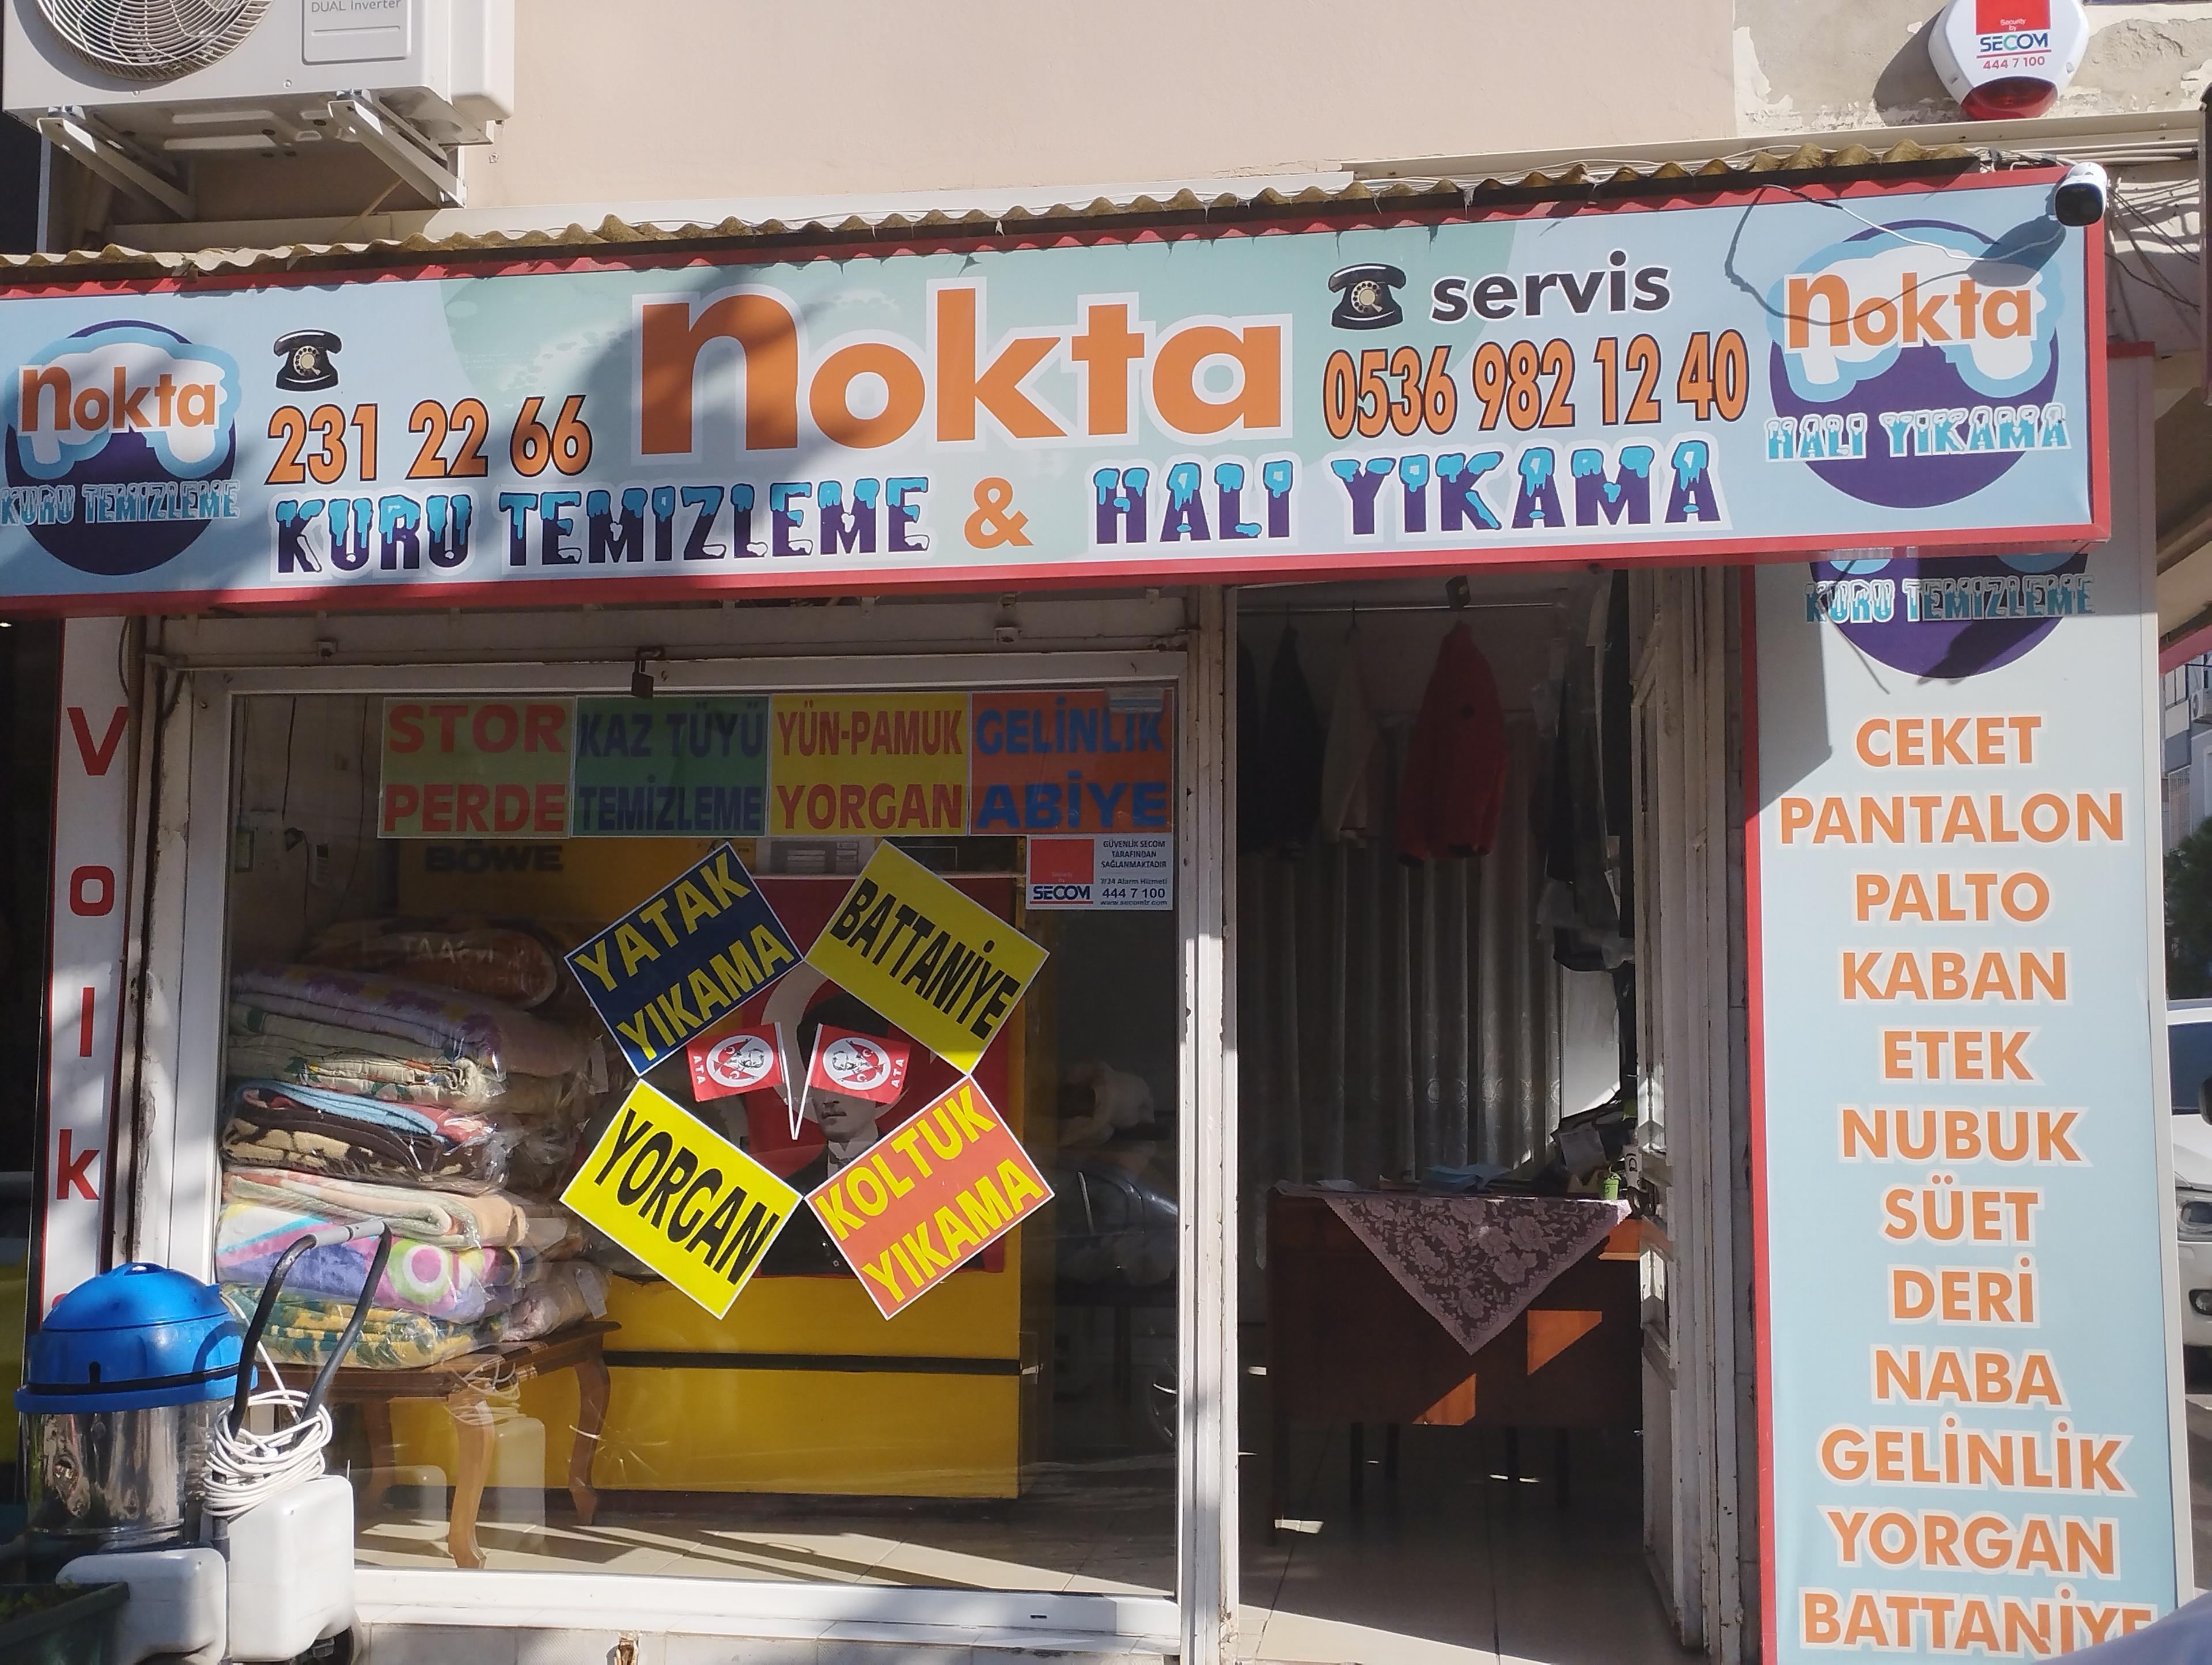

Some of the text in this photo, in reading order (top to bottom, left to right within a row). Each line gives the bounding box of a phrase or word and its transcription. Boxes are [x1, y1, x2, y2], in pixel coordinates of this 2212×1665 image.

[311, 0, 402, 13] DUAL Inverter
[2000, 18, 2026, 26] Security
[1980, 32, 2049, 52] SECOM
[1983, 56, 2045, 70] 444 7 100
[1431, 249, 1672, 321] servis
[1323, 328, 1749, 439] 0536 982 12 40
[264, 394, 593, 484] 231 22 66
[1765, 403, 2071, 460] HALI YIKAMA
[0, 479, 240, 525] KURU TEMIZLEME
[275, 439, 1721, 574] KURU TEMIZLEME & HALI YIKAMA
[1804, 574, 2096, 623] KURU TEMIZLEME
[388, 704, 566, 753] STOR
[579, 701, 764, 758] KAZ TÜYÜ
[777, 700, 963, 756] YÜN-PAMUK
[1855, 716, 2041, 767] CEKET
[384, 783, 566, 832] PERDE
[579, 775, 762, 832] TEMİZLEME
[776, 783, 962, 829] YORGAN
[978, 769, 1168, 829] ABİYE
[1780, 792, 2124, 844] PANTALON
[424, 840, 563, 873] BÖWE
[1101, 860, 1167, 868] SAĞLANMAKTADIR
[1103, 839, 1138, 848] GÜVENLİK
[1033, 885, 1090, 900] SECOM
[1102, 888, 1165, 898] 444 7 100
[1856, 872, 2050, 922] PALTO
[574, 851, 751, 992] YATAK
[829, 877, 1021, 1041] BATTANİYE
[1843, 952, 2067, 1000] KABAN
[615, 924, 794, 1061] YIKAMA
[692, 1055, 706, 1085] ATA
[892, 1059, 905, 1088] ATA
[1883, 1030, 2035, 1080] ETEK
[1842, 1109, 2082, 1162] NUBUK
[815, 1085, 997, 1241] KOLTUK
[593, 1108, 779, 1286] YORGAN
[1884, 1174, 2039, 1242] SÜET
[861, 1158, 1044, 1303] YIKAMA
[1892, 1257, 2034, 1323] DERİ
[1874, 1349, 2062, 1405] NABA
[1820, 1417, 2126, 1492] GELİNLİK
[1827, 1511, 2115, 1575] YORGAN
